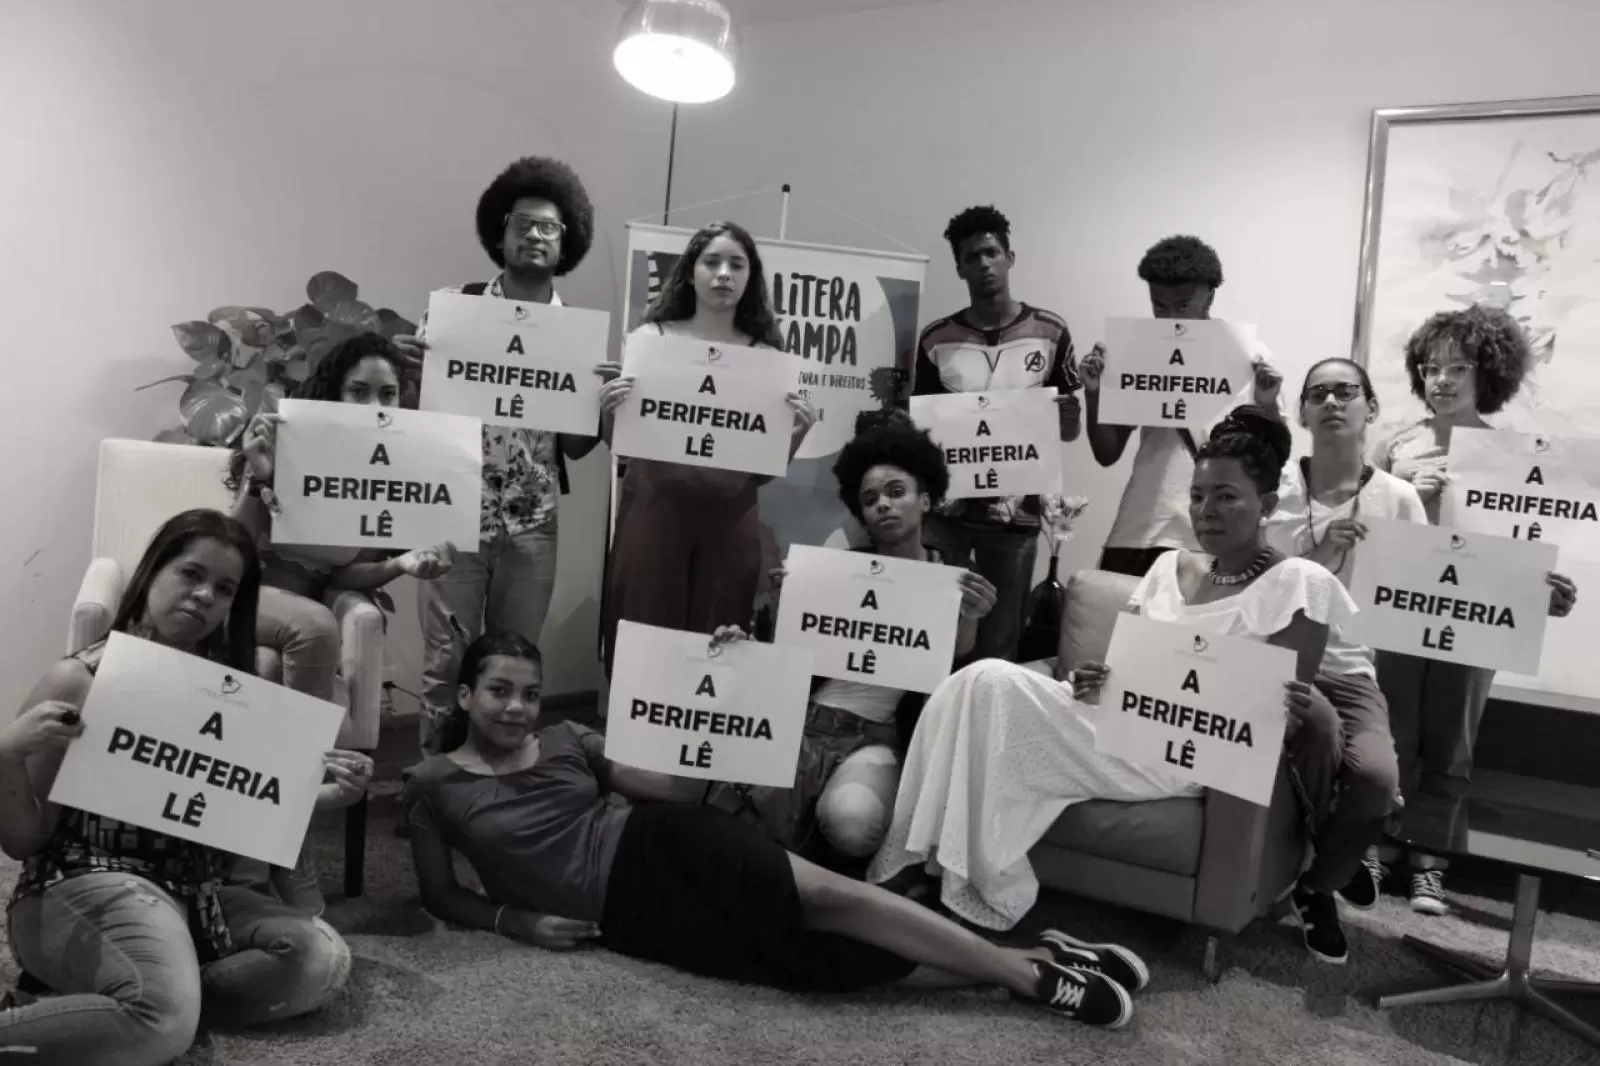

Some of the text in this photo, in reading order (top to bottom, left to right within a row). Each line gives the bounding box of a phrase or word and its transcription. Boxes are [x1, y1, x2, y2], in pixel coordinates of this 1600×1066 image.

[507, 335, 524, 354] A
[783, 319, 857, 366] AMPA
[1169, 349, 1184, 365] A
[448, 360, 576, 392] PERIFERIA
[699, 375, 716, 395] A
[1121, 374, 1231, 394] PERIFERIA
[495, 394, 524, 418] LÊ
[640, 398, 767, 433] PERIFERIA
[1162, 399, 1185, 419] LÊ
[976, 420, 990, 436] A
[370, 444, 390, 465] A
[685, 433, 715, 457] LÊ
[946, 444, 1039, 464] ERIFERIA
[975, 468, 998, 489] LÊ
[1526, 466, 1543, 485] A
[304, 476, 451, 505] PERIFERIA
[1466, 490, 1597, 521] PERIFERIA
[360, 510, 392, 537] LÊ
[1440, 565, 1458, 585] A
[860, 590, 877, 610] A
[1375, 585, 1515, 629] PERIFERIA
[800, 612, 931, 650] PERIFERIA
[1422, 626, 1454, 651] LÊ
[847, 650, 876, 674] LÊ
[696, 675, 715, 697] A
[1181, 670, 1199, 693] A
[199, 712, 222, 740] A
[631, 699, 772, 740] PERIFERIA
[1121, 690, 1253, 748] PERIFERIA
[107, 726, 280, 806] PERIFERIA
[680, 741, 712, 768] LÊ
[1165, 740, 1195, 769] LÊ
[162, 792, 206, 827] LÊ
